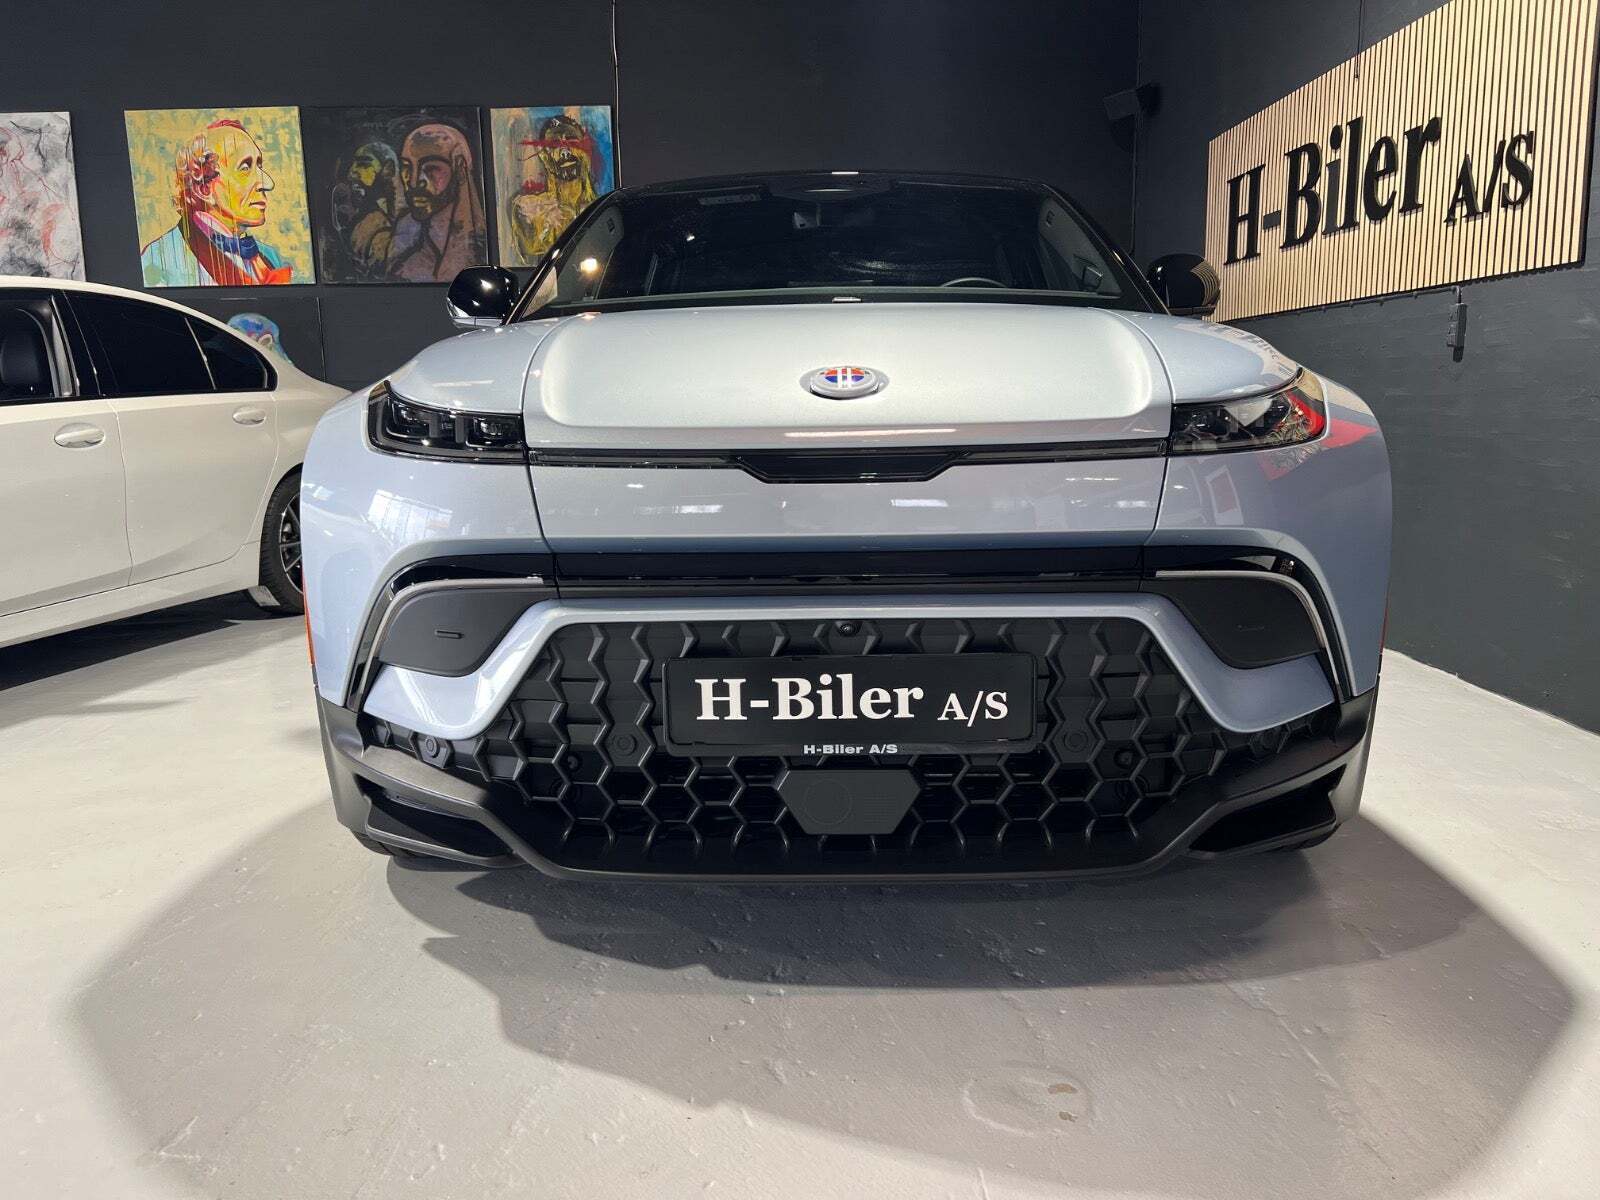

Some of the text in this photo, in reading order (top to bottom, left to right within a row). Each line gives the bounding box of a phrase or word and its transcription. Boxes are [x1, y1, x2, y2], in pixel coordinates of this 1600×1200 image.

[1223, 116, 1535, 265] H-Biler A/S
[694, 673, 1009, 727] H-Biler A/S
[803, 744, 898, 755] H-Biler A/S
